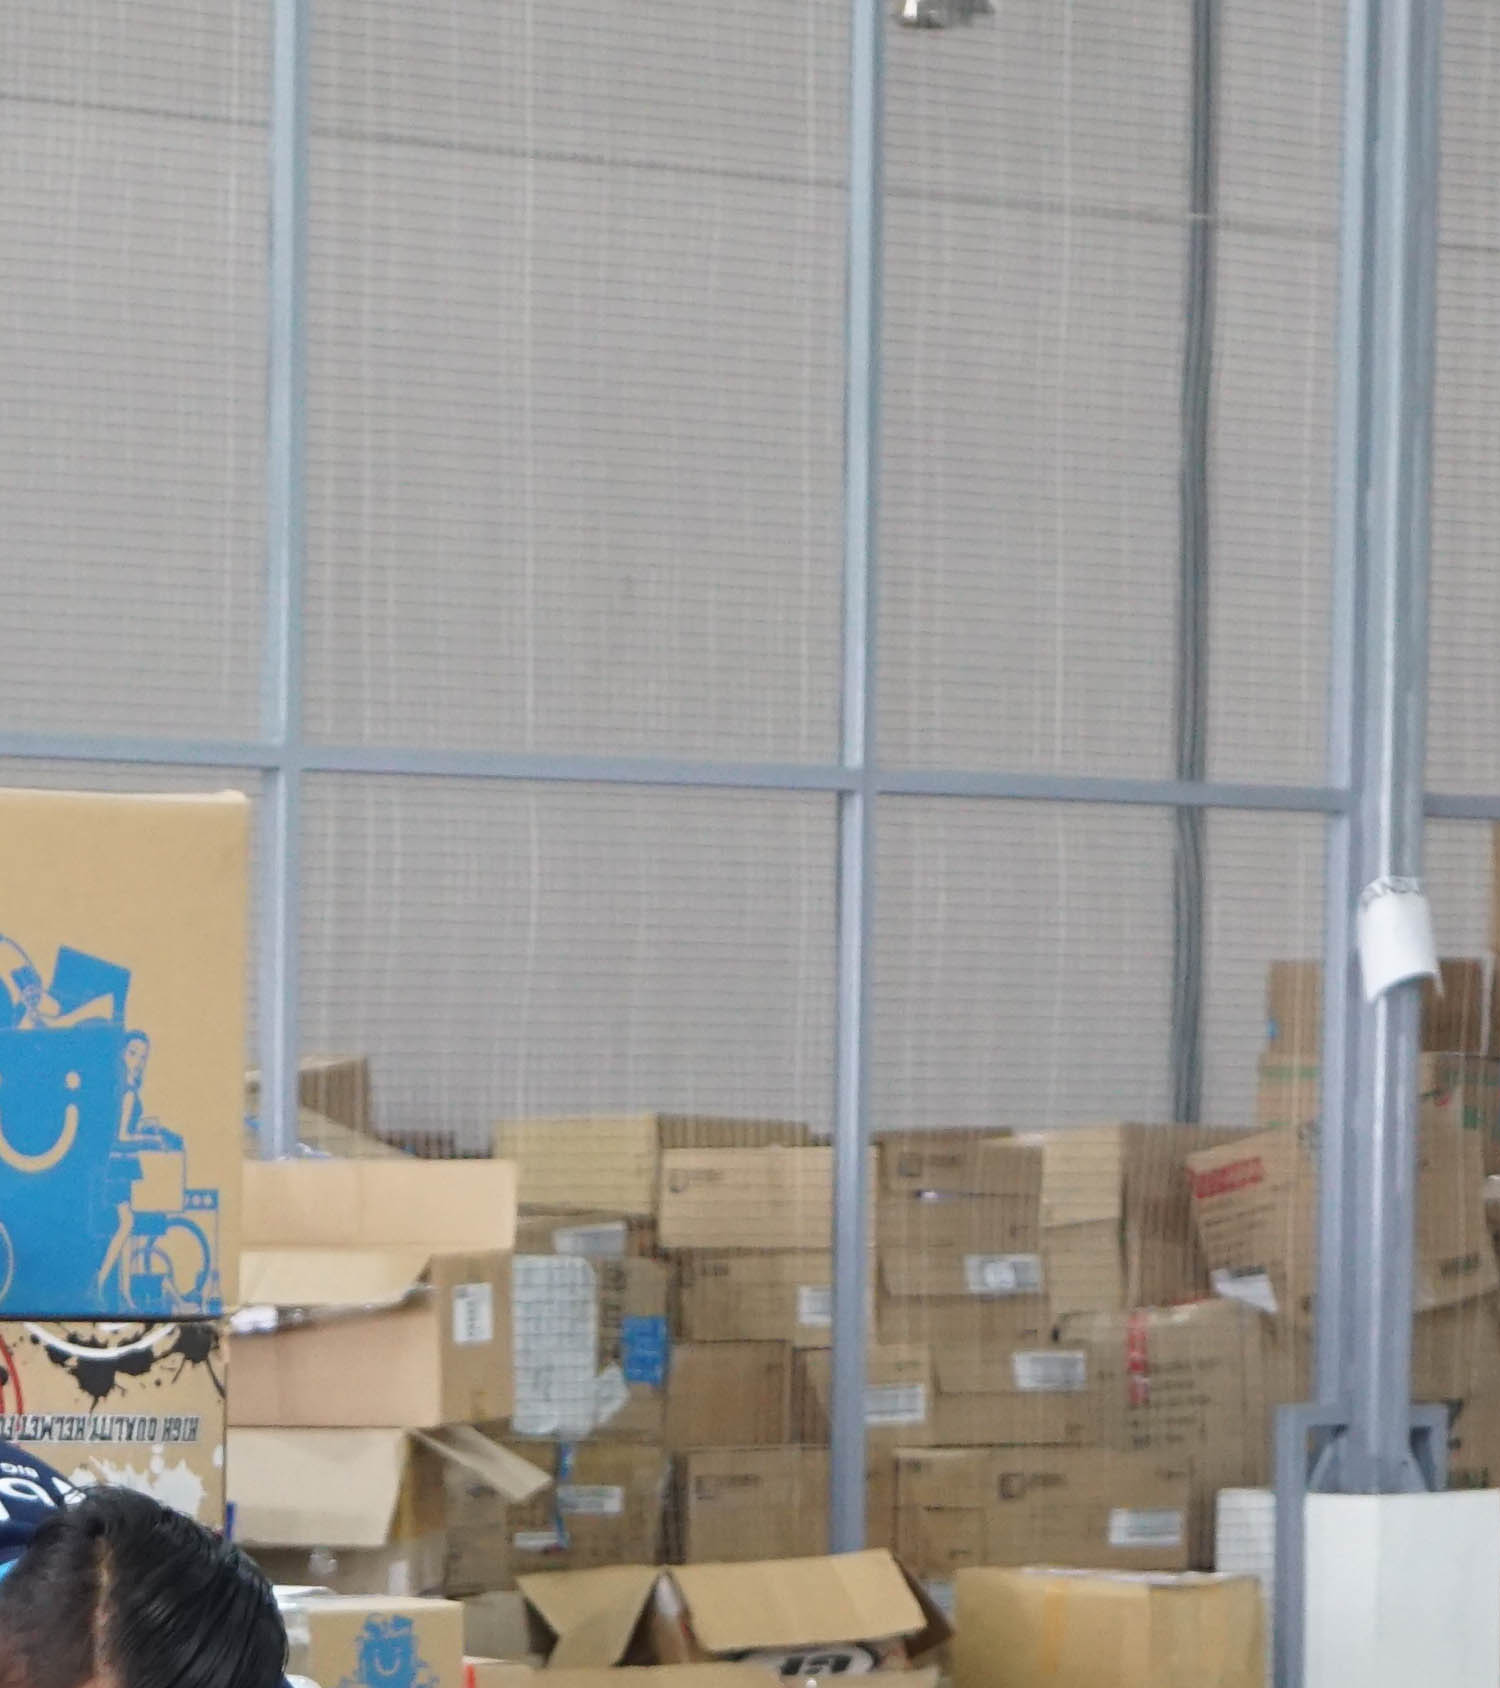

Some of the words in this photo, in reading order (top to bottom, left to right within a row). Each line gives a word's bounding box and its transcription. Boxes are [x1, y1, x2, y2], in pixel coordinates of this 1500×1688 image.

[18, 1416, 87, 1442] HELMET
[90, 1416, 158, 1443] QUALITY
[163, 1417, 201, 1444] HIGH
[0, 1462, 39, 1477] BIG
